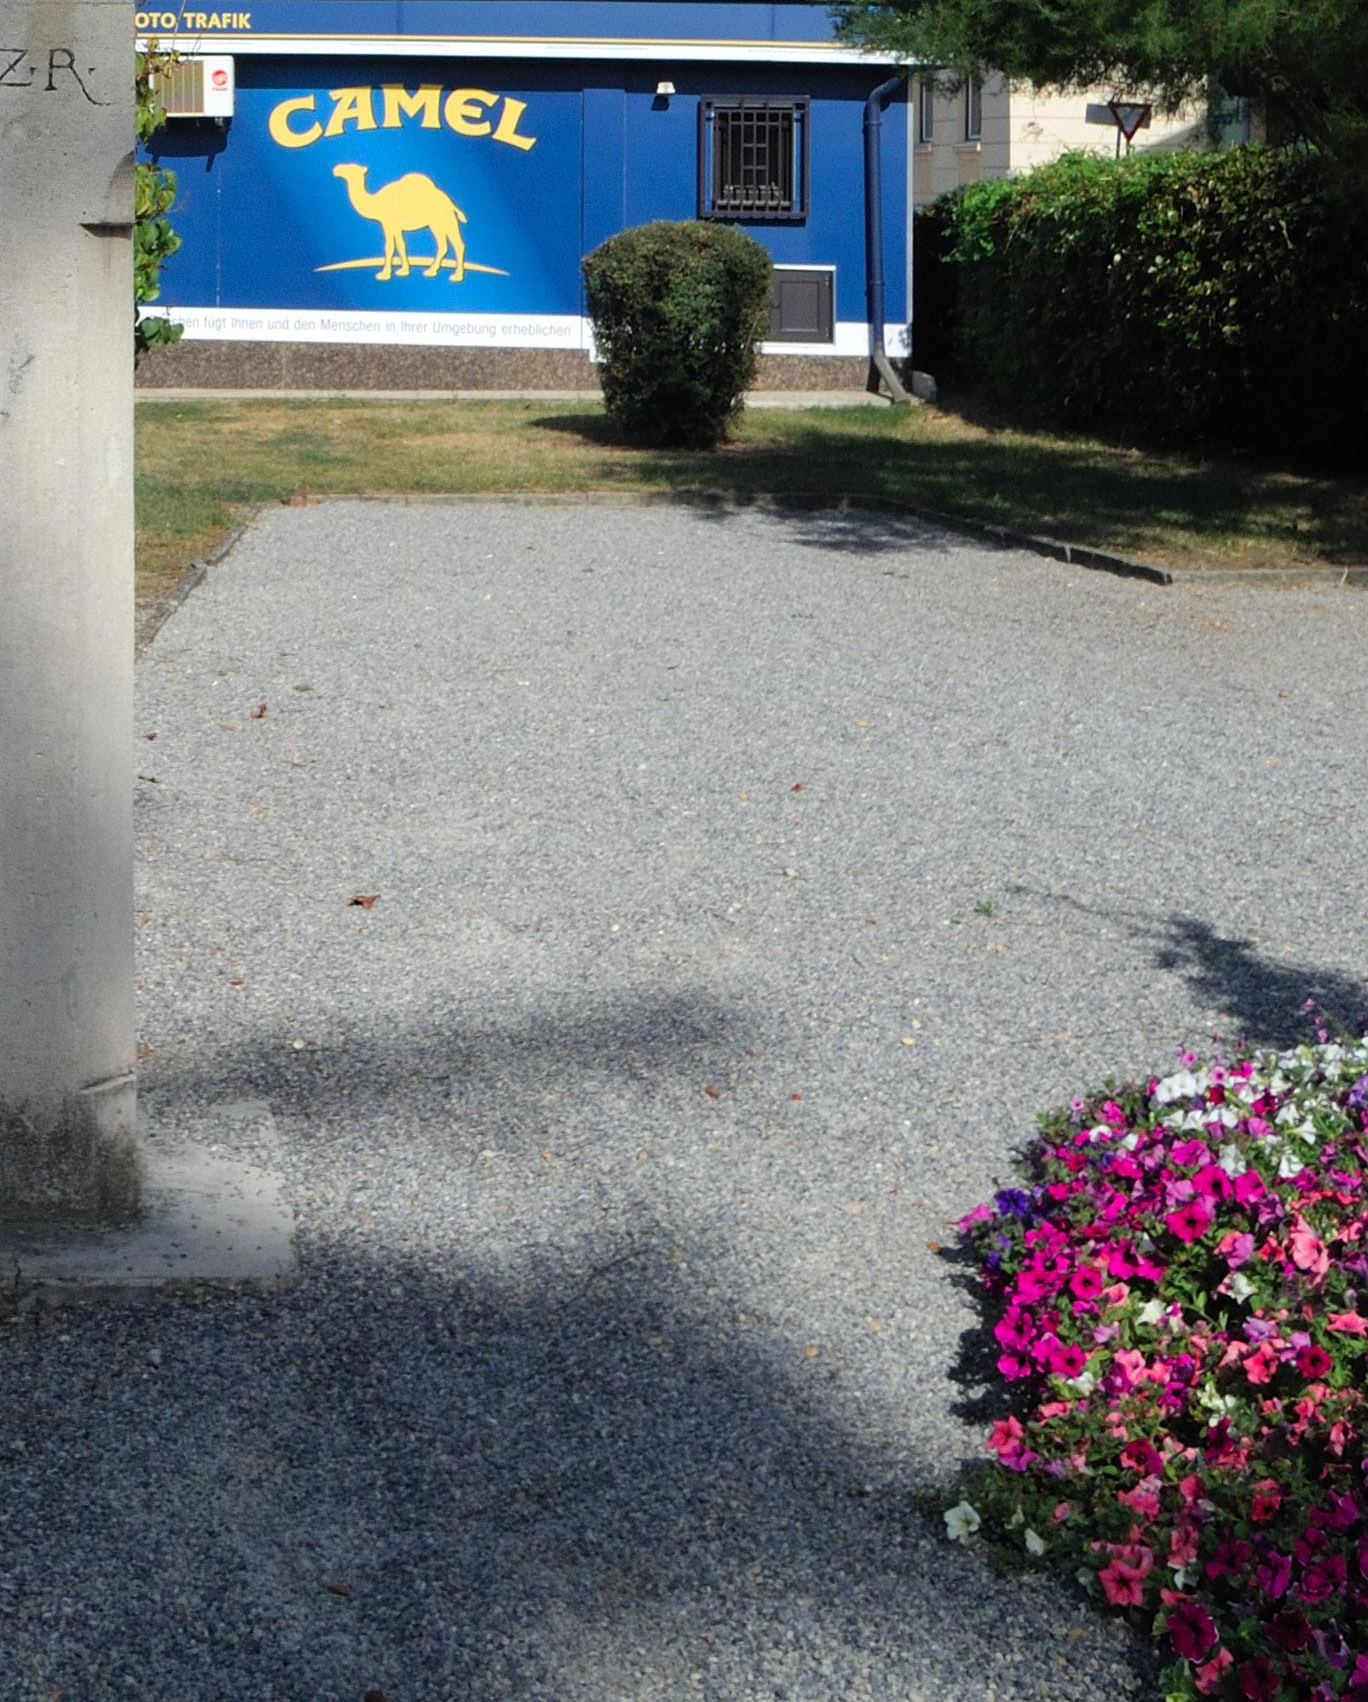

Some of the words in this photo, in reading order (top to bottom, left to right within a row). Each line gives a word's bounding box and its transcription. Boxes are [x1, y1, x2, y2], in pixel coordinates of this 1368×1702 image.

[183, 12, 252, 29] TRAFIK
[268, 83, 537, 151] CAMEL
[203, 316, 227, 332] fügt
[231, 317, 263, 330] Ihnen
[267, 317, 289, 331] und
[294, 317, 316, 331] den
[320, 319, 380, 332] Menschen
[385, 320, 396, 332] in
[400, 320, 428, 333] Ihrer
[432, 321, 497, 337] Umgebung
[501, 323, 571, 337] erheblichen
